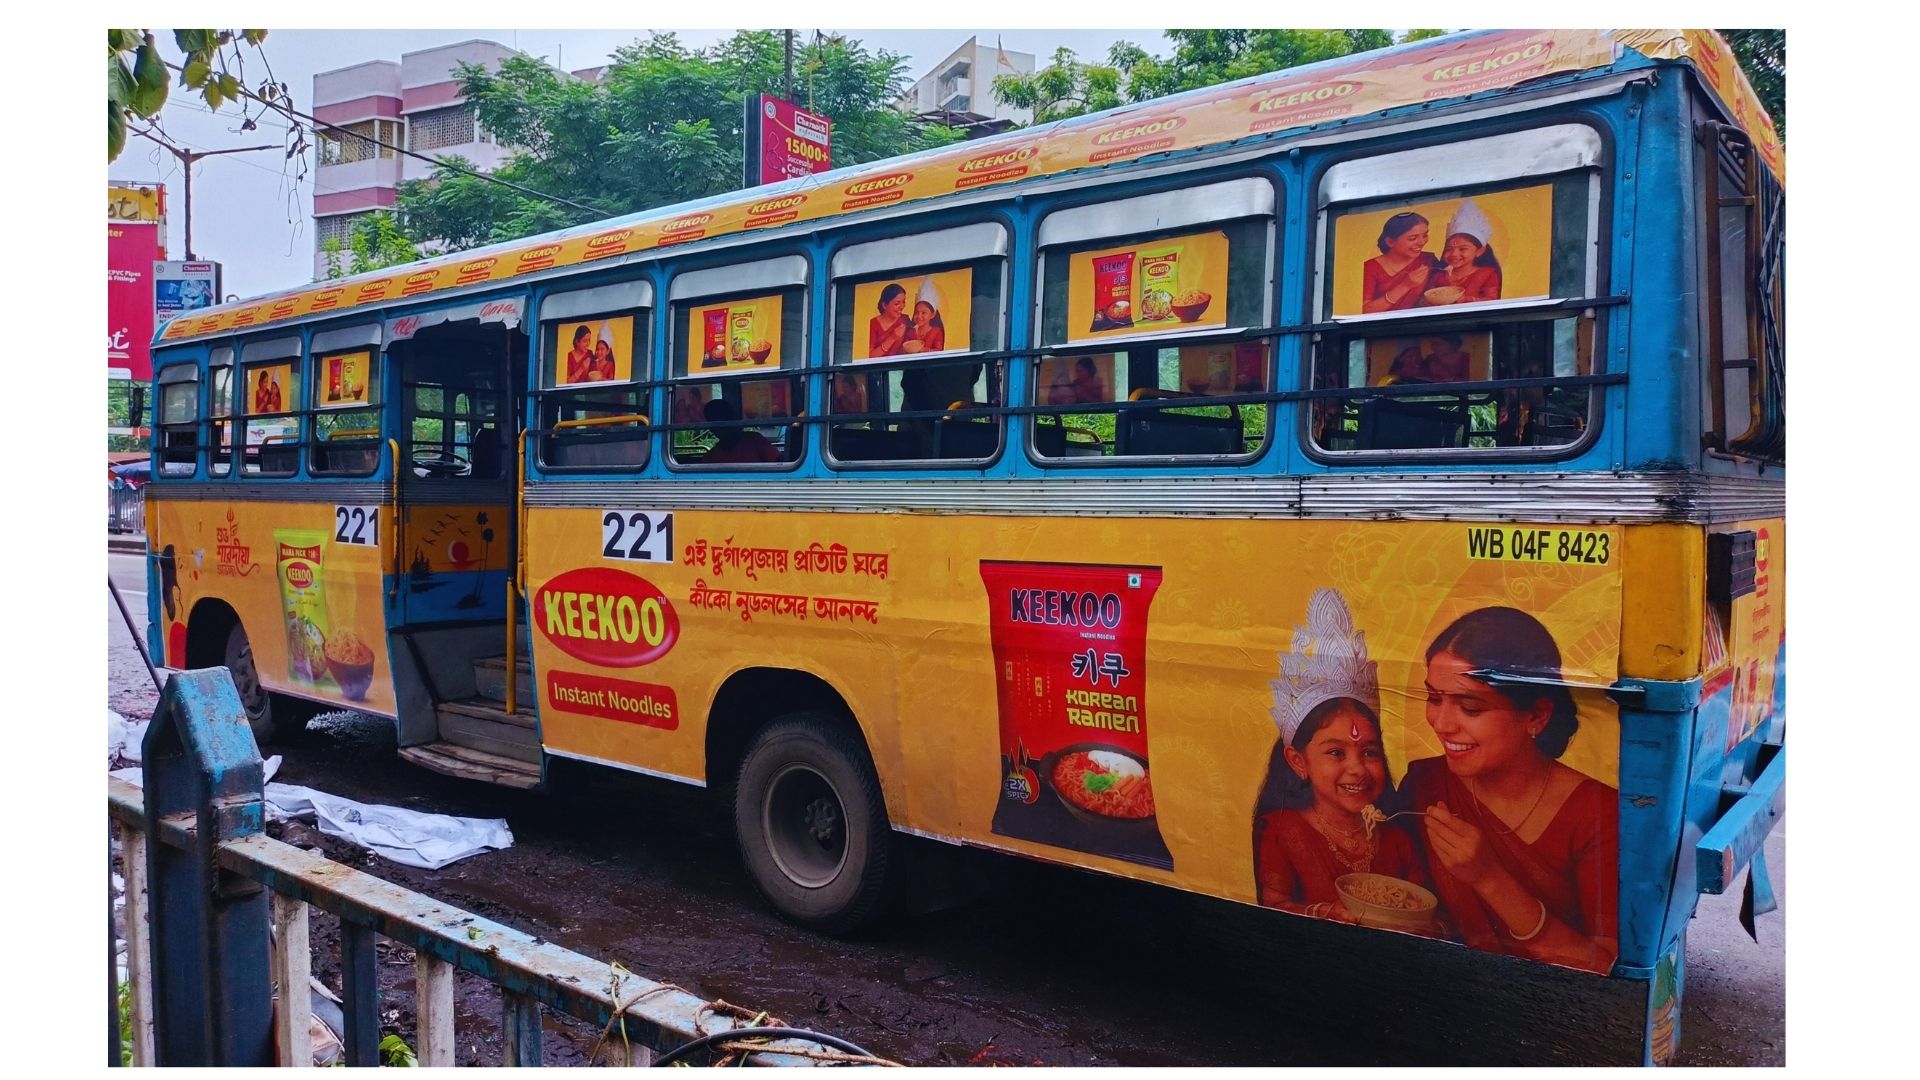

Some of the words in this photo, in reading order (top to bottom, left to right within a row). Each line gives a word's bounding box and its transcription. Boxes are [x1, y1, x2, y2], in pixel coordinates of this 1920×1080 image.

[1433, 44, 1542, 80] KEEKOO
[1258, 84, 1353, 112] KEEKOO
[797, 116, 826, 133] Charnock
[1254, 116, 1294, 129] Instant
[1298, 107, 1348, 119] Noodles
[1098, 119, 1178, 144] KEEKOO
[785, 137, 828, 162] 15000+
[1093, 148, 1127, 160] Instant
[1129, 141, 1171, 153] Noodles
[787, 154, 813, 169] Successful
[963, 149, 1030, 171] KEEKOO
[850, 175, 907, 194] KEEKOO
[958, 175, 987, 186] Instant
[988, 168, 1024, 180] Noodles
[751, 196, 803, 213] KEEKOO
[844, 200, 869, 209] Instant
[870, 192, 900, 203] Noodles
[664, 215, 709, 231] KEEKOO
[746, 218, 768, 227] Instant
[769, 212, 795, 222] Noodles
[589, 231, 630, 246] KEEKOO
[522, 246, 559, 260] KEEKOO
[461, 259, 495, 272] KEEKOO
[1149, 264, 1169, 274] KEEKOO
[336, 507, 378, 545] 221
[603, 512, 673, 562] 221
[1468, 528, 1504, 558] WB
[1512, 530, 1551, 560] 04F
[1558, 532, 1610, 564] 8423
[683, 537, 707, 567] এই
[711, 535, 788, 582] দুর্গাপূজায়
[793, 542, 848, 574] প্রতিটি
[853, 553, 889, 580] ঘরে
[287, 567, 311, 582] KEEKOO
[689, 578, 732, 612] কীকো
[736, 591, 808, 623] নুডলসের
[813, 597, 879, 625] আনন্দ
[1011, 588, 1121, 629] KEEKOO
[543, 590, 665, 647] KEEKOO
[1071, 648, 1130, 688] 키쿠
[554, 682, 606, 708] Instant
[608, 690, 672, 719] Noodles
[1009, 778, 1026, 791] 2X
[1007, 790, 1030, 799] SPICY
